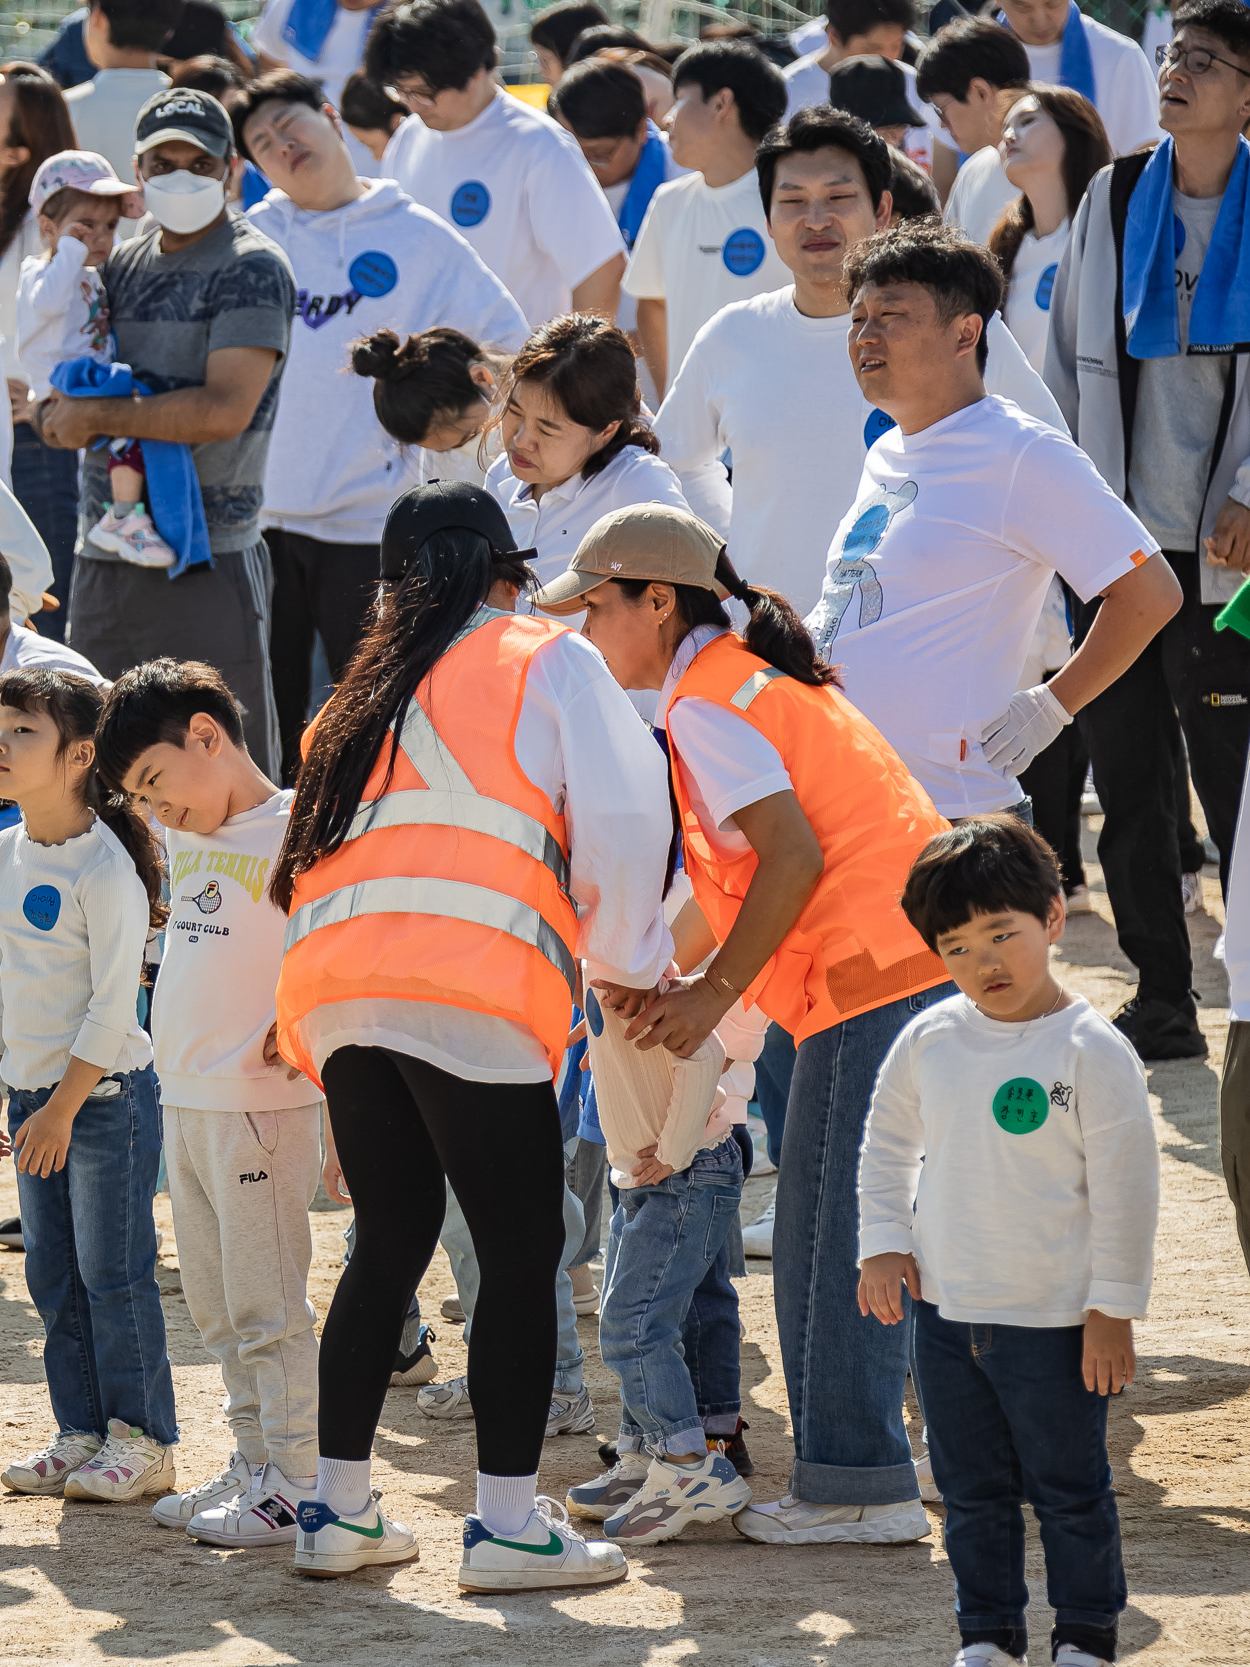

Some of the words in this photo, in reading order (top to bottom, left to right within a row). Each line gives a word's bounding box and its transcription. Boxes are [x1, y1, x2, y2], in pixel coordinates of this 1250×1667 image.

[155, 101, 206, 118] LOCAL
[206, 851, 270, 904] TENNIS
[203, 924, 230, 936] CULB
[239, 1170, 268, 1184] FILA
